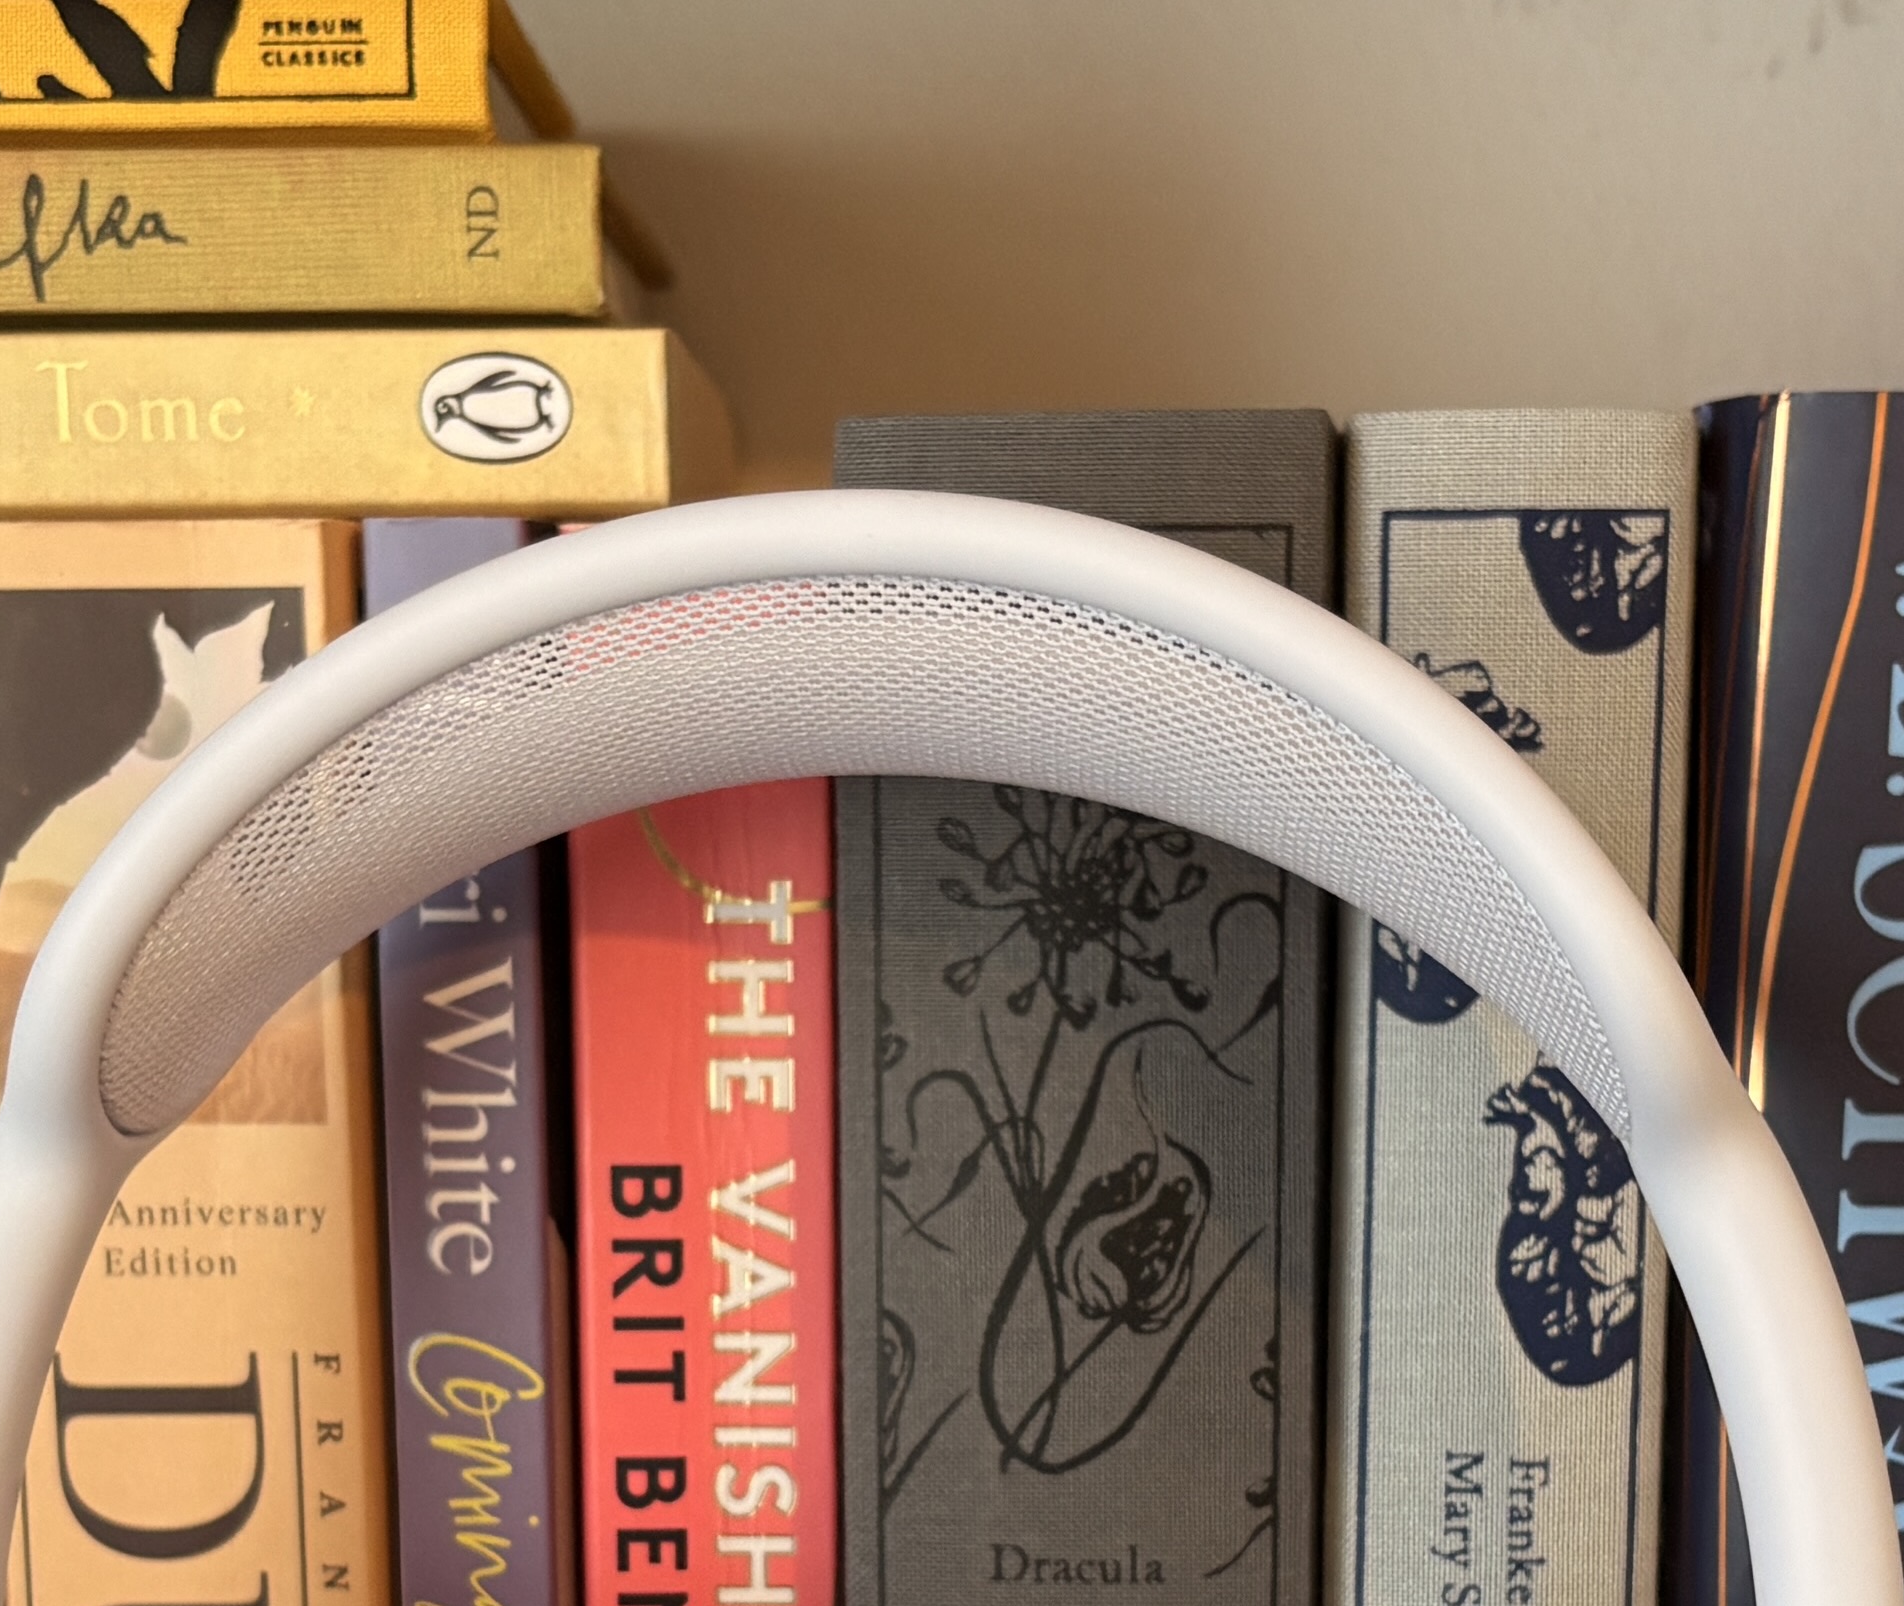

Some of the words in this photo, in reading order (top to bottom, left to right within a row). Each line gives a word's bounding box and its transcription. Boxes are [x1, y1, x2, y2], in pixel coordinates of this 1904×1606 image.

[260, 18, 365, 38] PENGUIN
[260, 48, 367, 68] CLASSICS
[465, 184, 501, 261] ND
[34, 358, 248, 445] Tome
[704, 879, 796, 1114] THE
[420, 955, 519, 1277] White
[106, 1199, 327, 1235] Anniversary
[102, 1247, 239, 1278] Edition
[608, 1163, 687, 1403] BRIT
[1430, 1451, 1484, 1570] Mary
[988, 1542, 1167, 1588] Dracula
